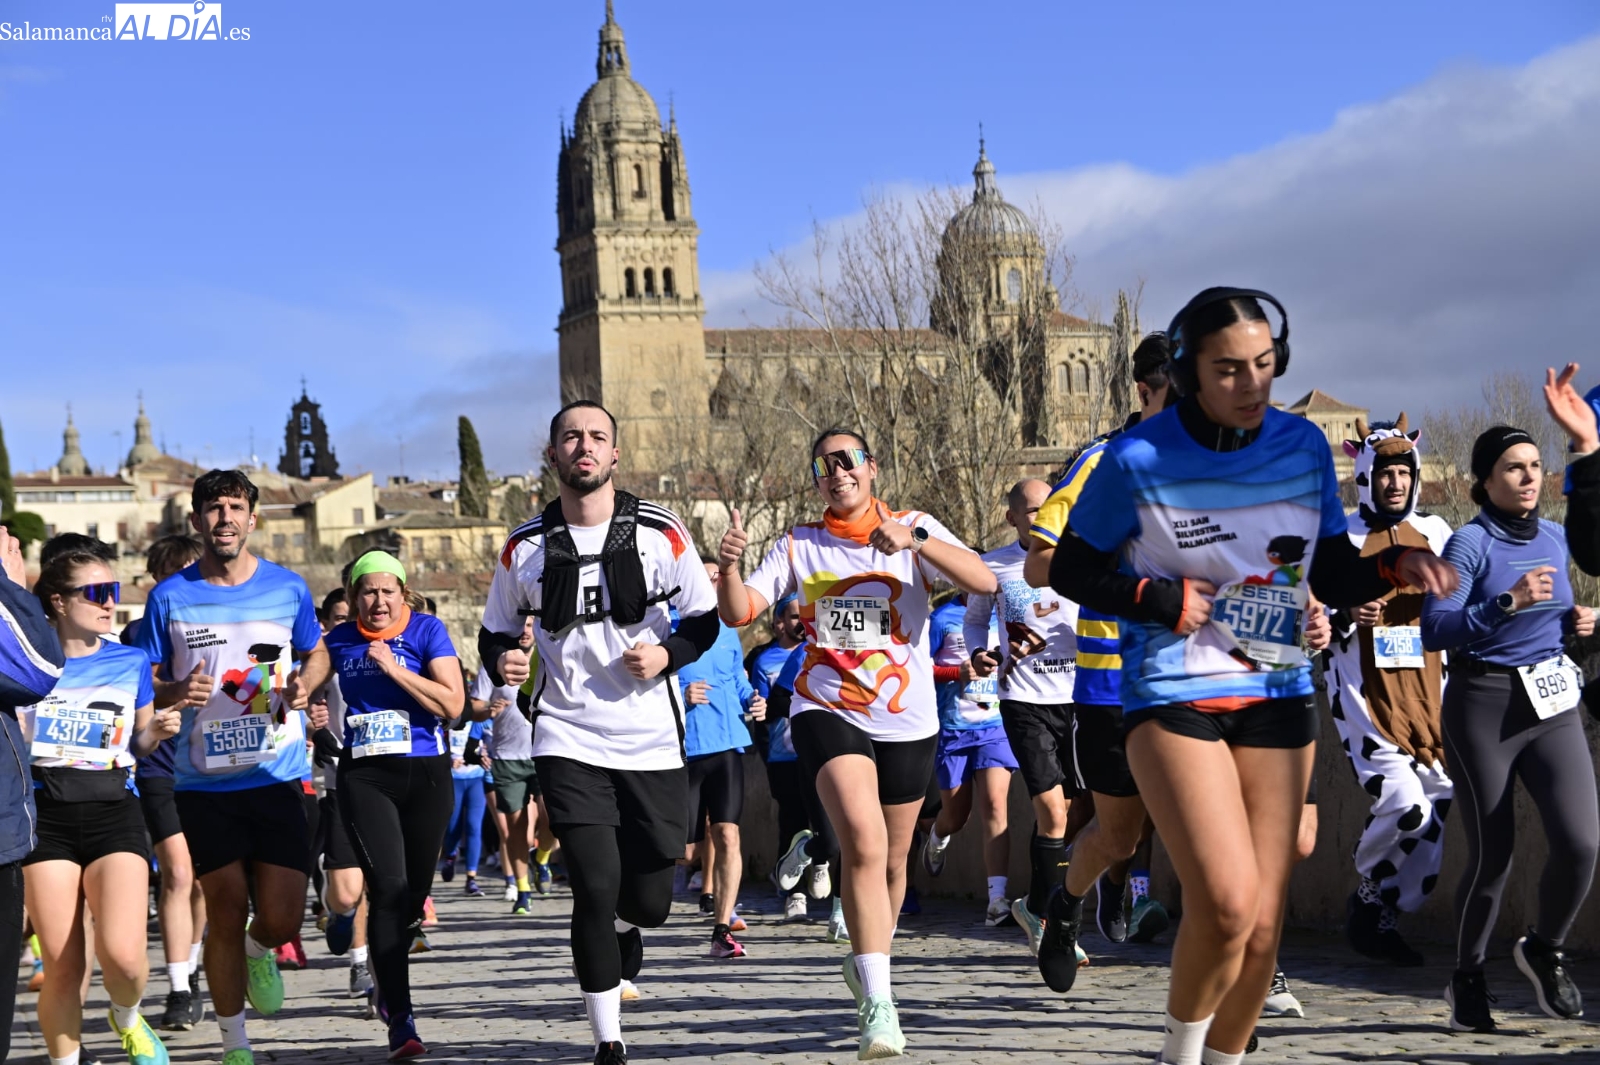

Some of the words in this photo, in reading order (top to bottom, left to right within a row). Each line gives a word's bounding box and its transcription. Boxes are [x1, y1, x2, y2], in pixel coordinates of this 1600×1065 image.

[1190, 515, 1209, 527] SAN
[1175, 524, 1221, 539] SILVESTRE
[1178, 532, 1238, 549] SALMANTINA
[1241, 585, 1297, 605] SETEL
[833, 599, 882, 609] SETEL
[830, 610, 865, 632] 249
[1223, 599, 1286, 638] 5972
[186, 633, 217, 643] SILVESTRE
[196, 627, 209, 635] SAN
[1389, 628, 1421, 636] SETEL
[187, 638, 228, 650] SALMANTINA
[1383, 637, 1414, 654] 2158
[1043, 658, 1058, 666] SAN
[1059, 657, 1077, 666] SILV
[1535, 672, 1568, 699] 898
[57, 708, 106, 722] SETEL
[363, 712, 398, 721] SETE
[221, 716, 266, 729] SETEL
[46, 718, 92, 743] 4312
[359, 721, 395, 742] 2423
[213, 727, 259, 752] 5580
